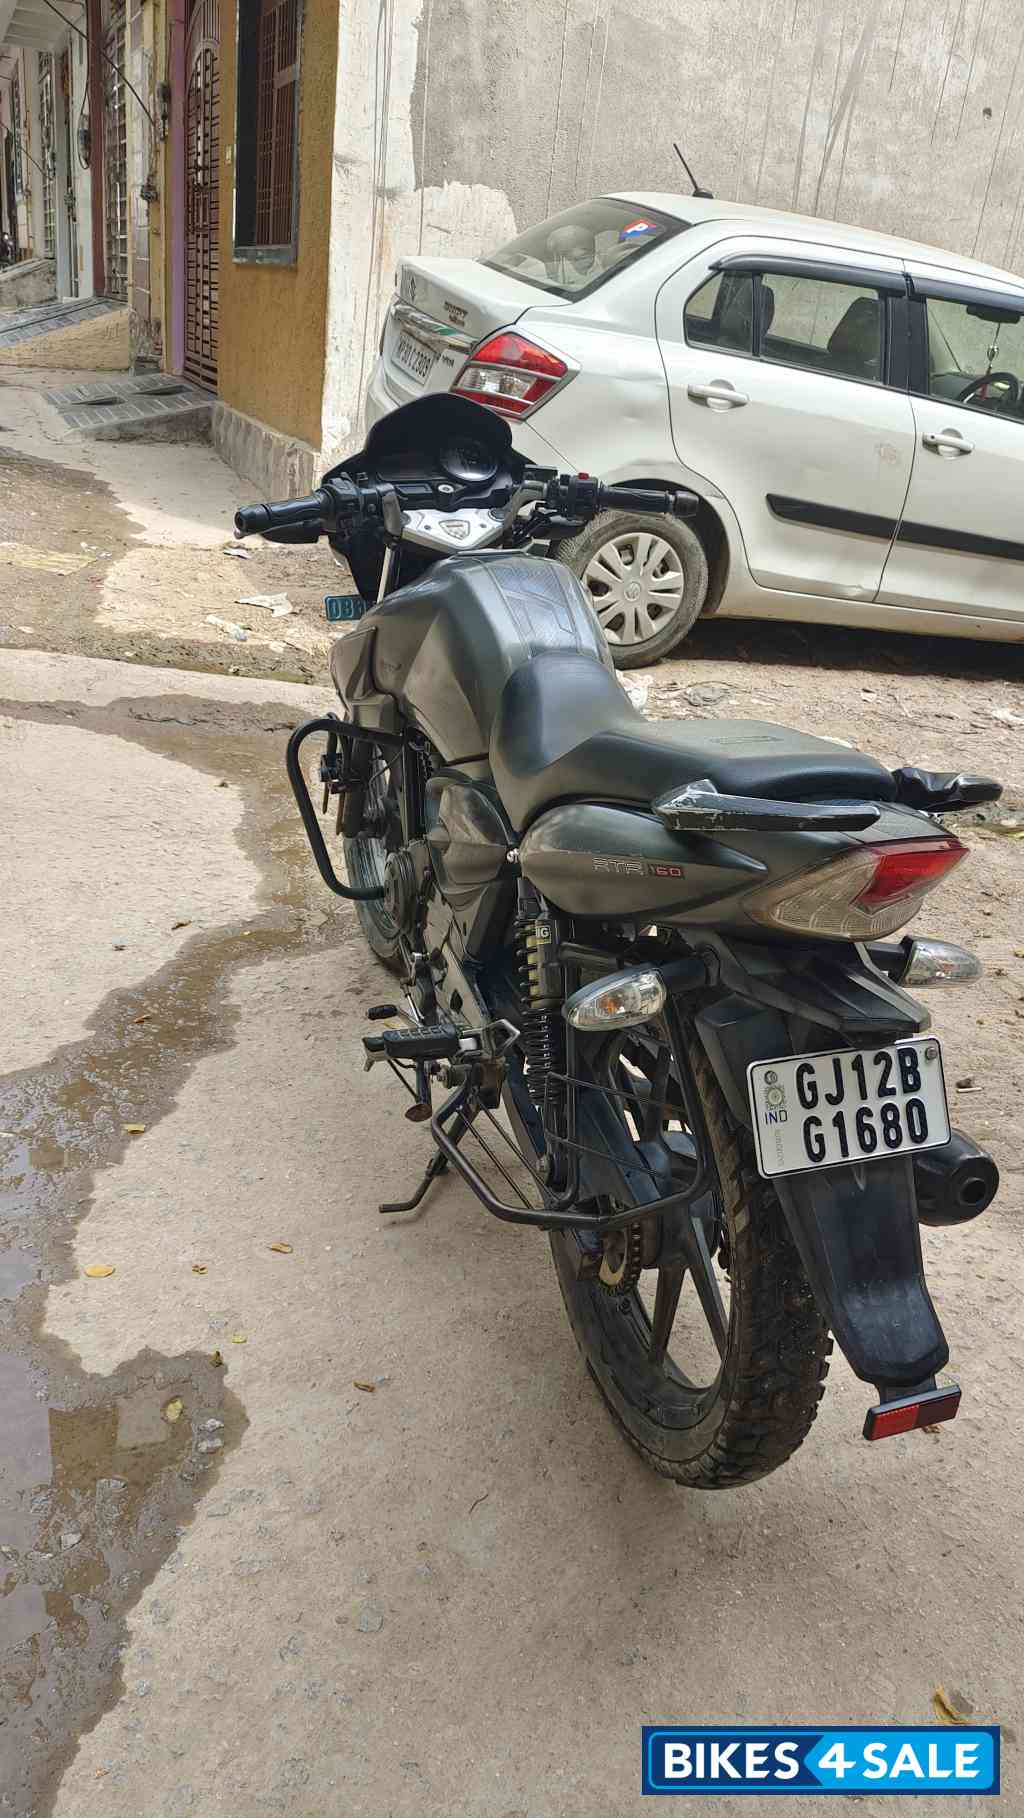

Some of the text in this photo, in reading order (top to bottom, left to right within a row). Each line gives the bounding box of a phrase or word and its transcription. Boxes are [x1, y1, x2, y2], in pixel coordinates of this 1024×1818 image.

[795, 1047, 922, 1110] GJ12B
[765, 1109, 788, 1125] IND
[803, 1098, 929, 1163] G1680
